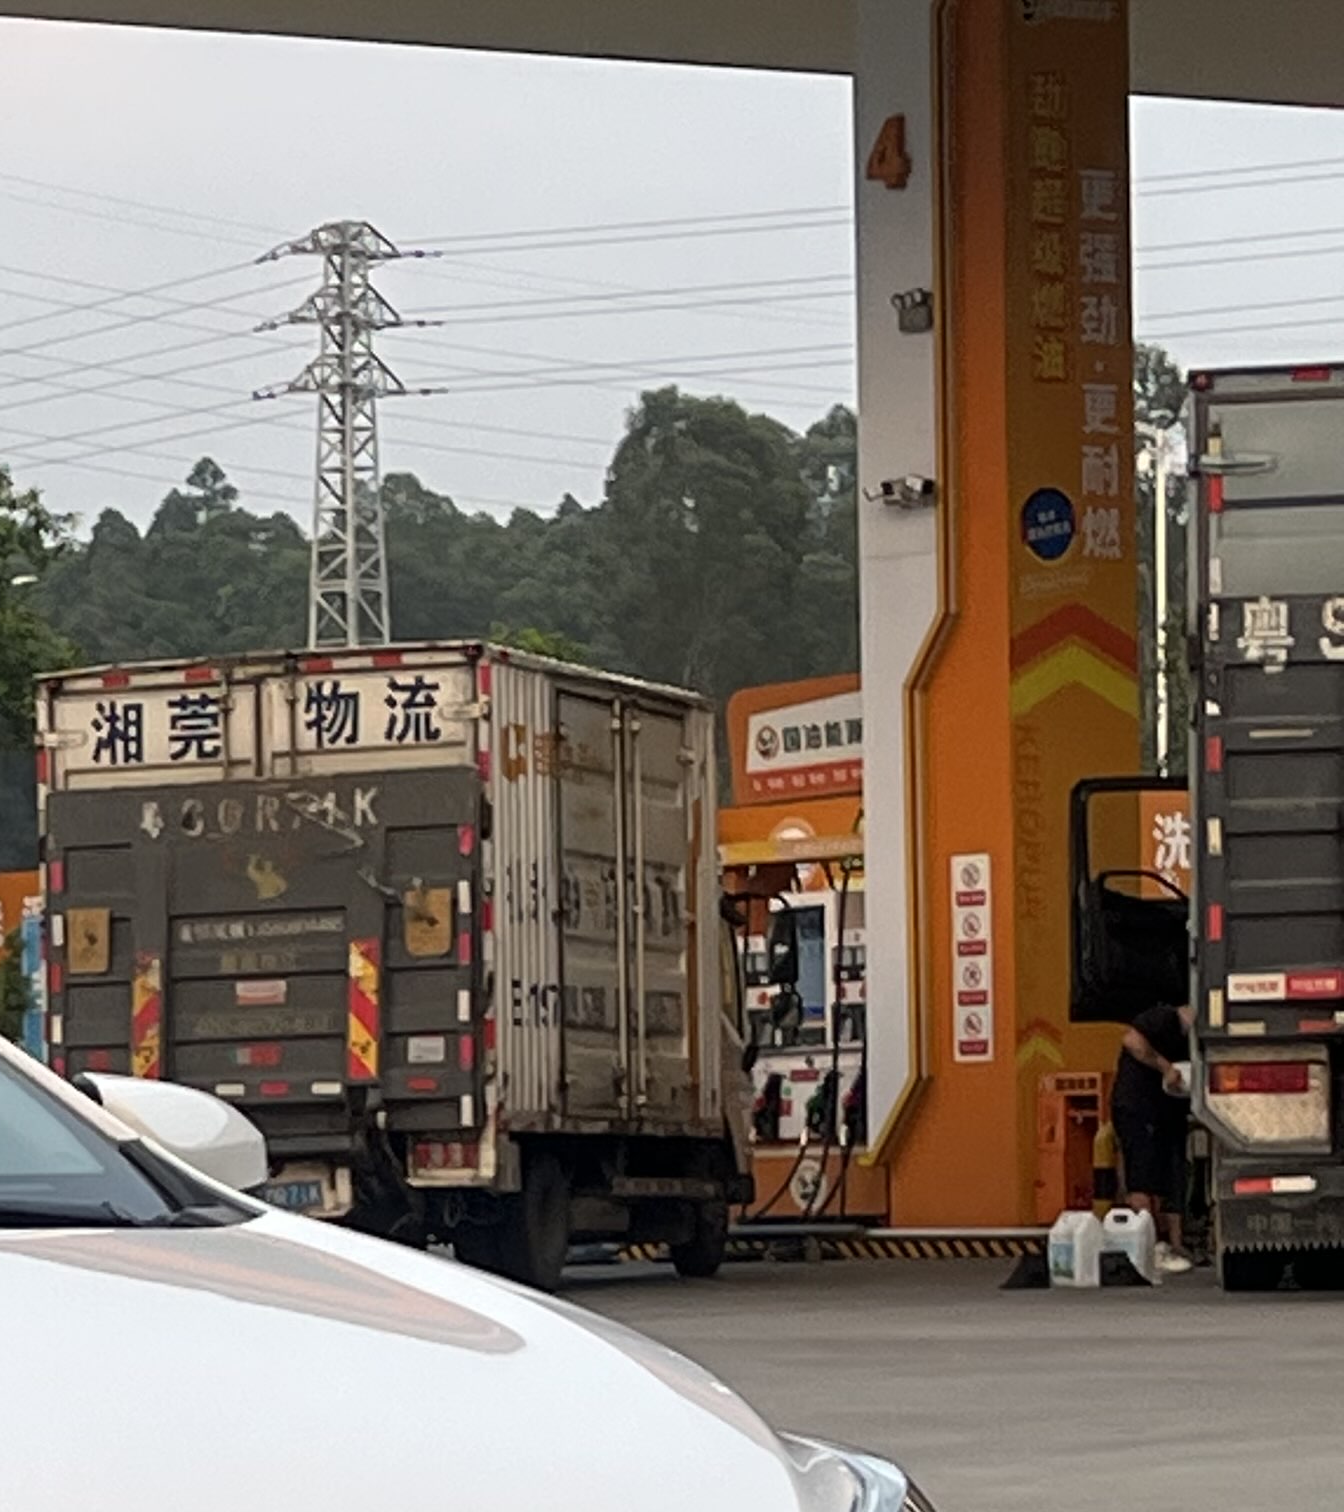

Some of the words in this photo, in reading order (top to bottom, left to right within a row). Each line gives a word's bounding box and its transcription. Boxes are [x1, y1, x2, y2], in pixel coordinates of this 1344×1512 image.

[867, 113, 911, 190] 4
[91, 676, 443, 764] 湘莞物流
